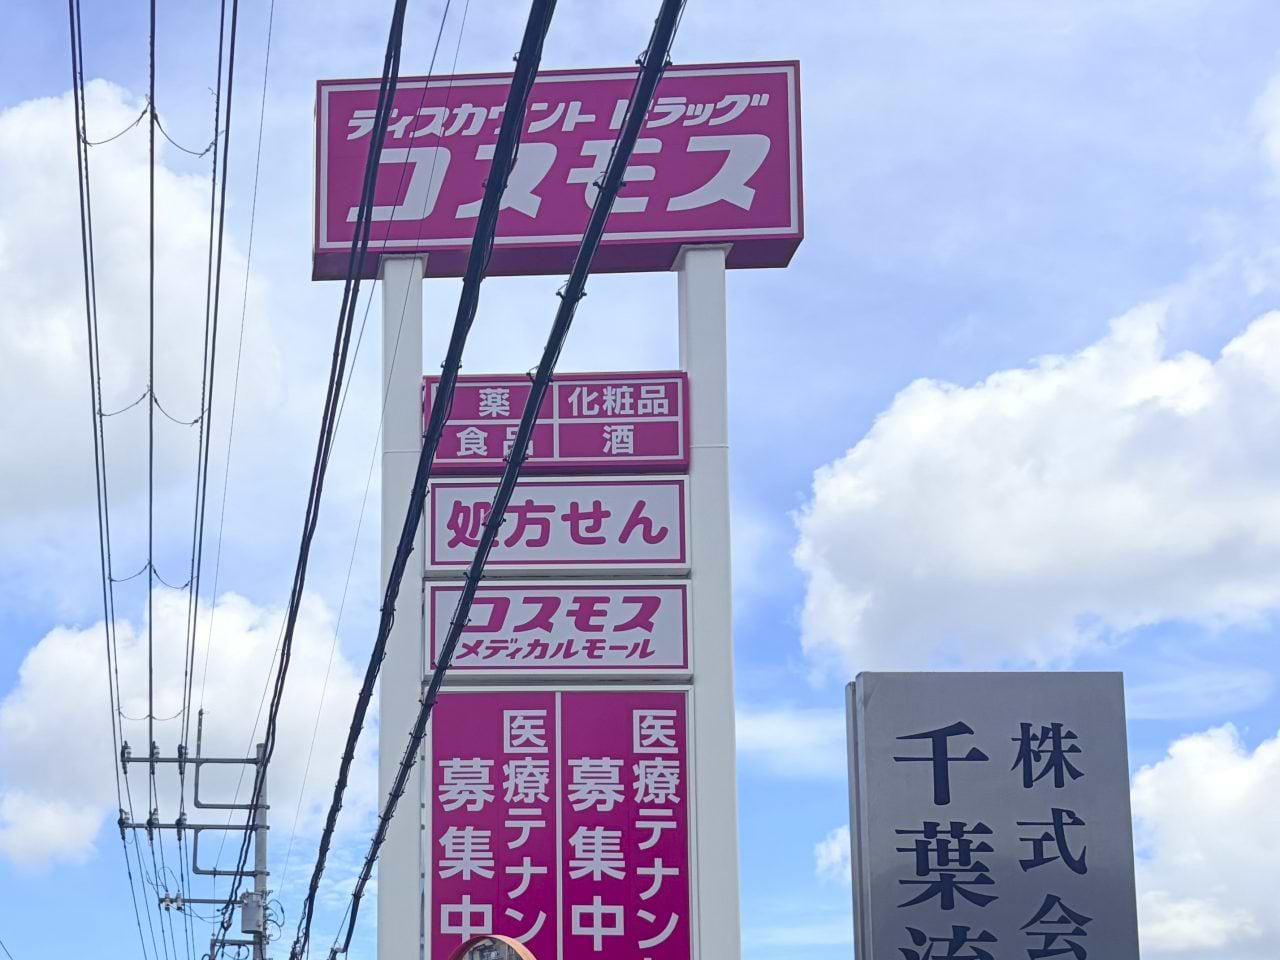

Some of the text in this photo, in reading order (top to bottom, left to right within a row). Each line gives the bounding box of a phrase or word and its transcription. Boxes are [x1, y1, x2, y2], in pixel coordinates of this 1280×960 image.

[346, 133, 771, 222] コスモス
[478, 387, 511, 417] 薬
[568, 385, 670, 416] 化粧品
[456, 426, 534, 456] 食品
[602, 425, 635, 455] 酒
[447, 499, 668, 548] 処方せん
[461, 596, 662, 633] コスモス
[456, 638, 656, 660] メディカルモール
[503, 709, 550, 944] 医療テナン
[438, 757, 496, 943] 募集中
[567, 756, 626, 951] 募集中
